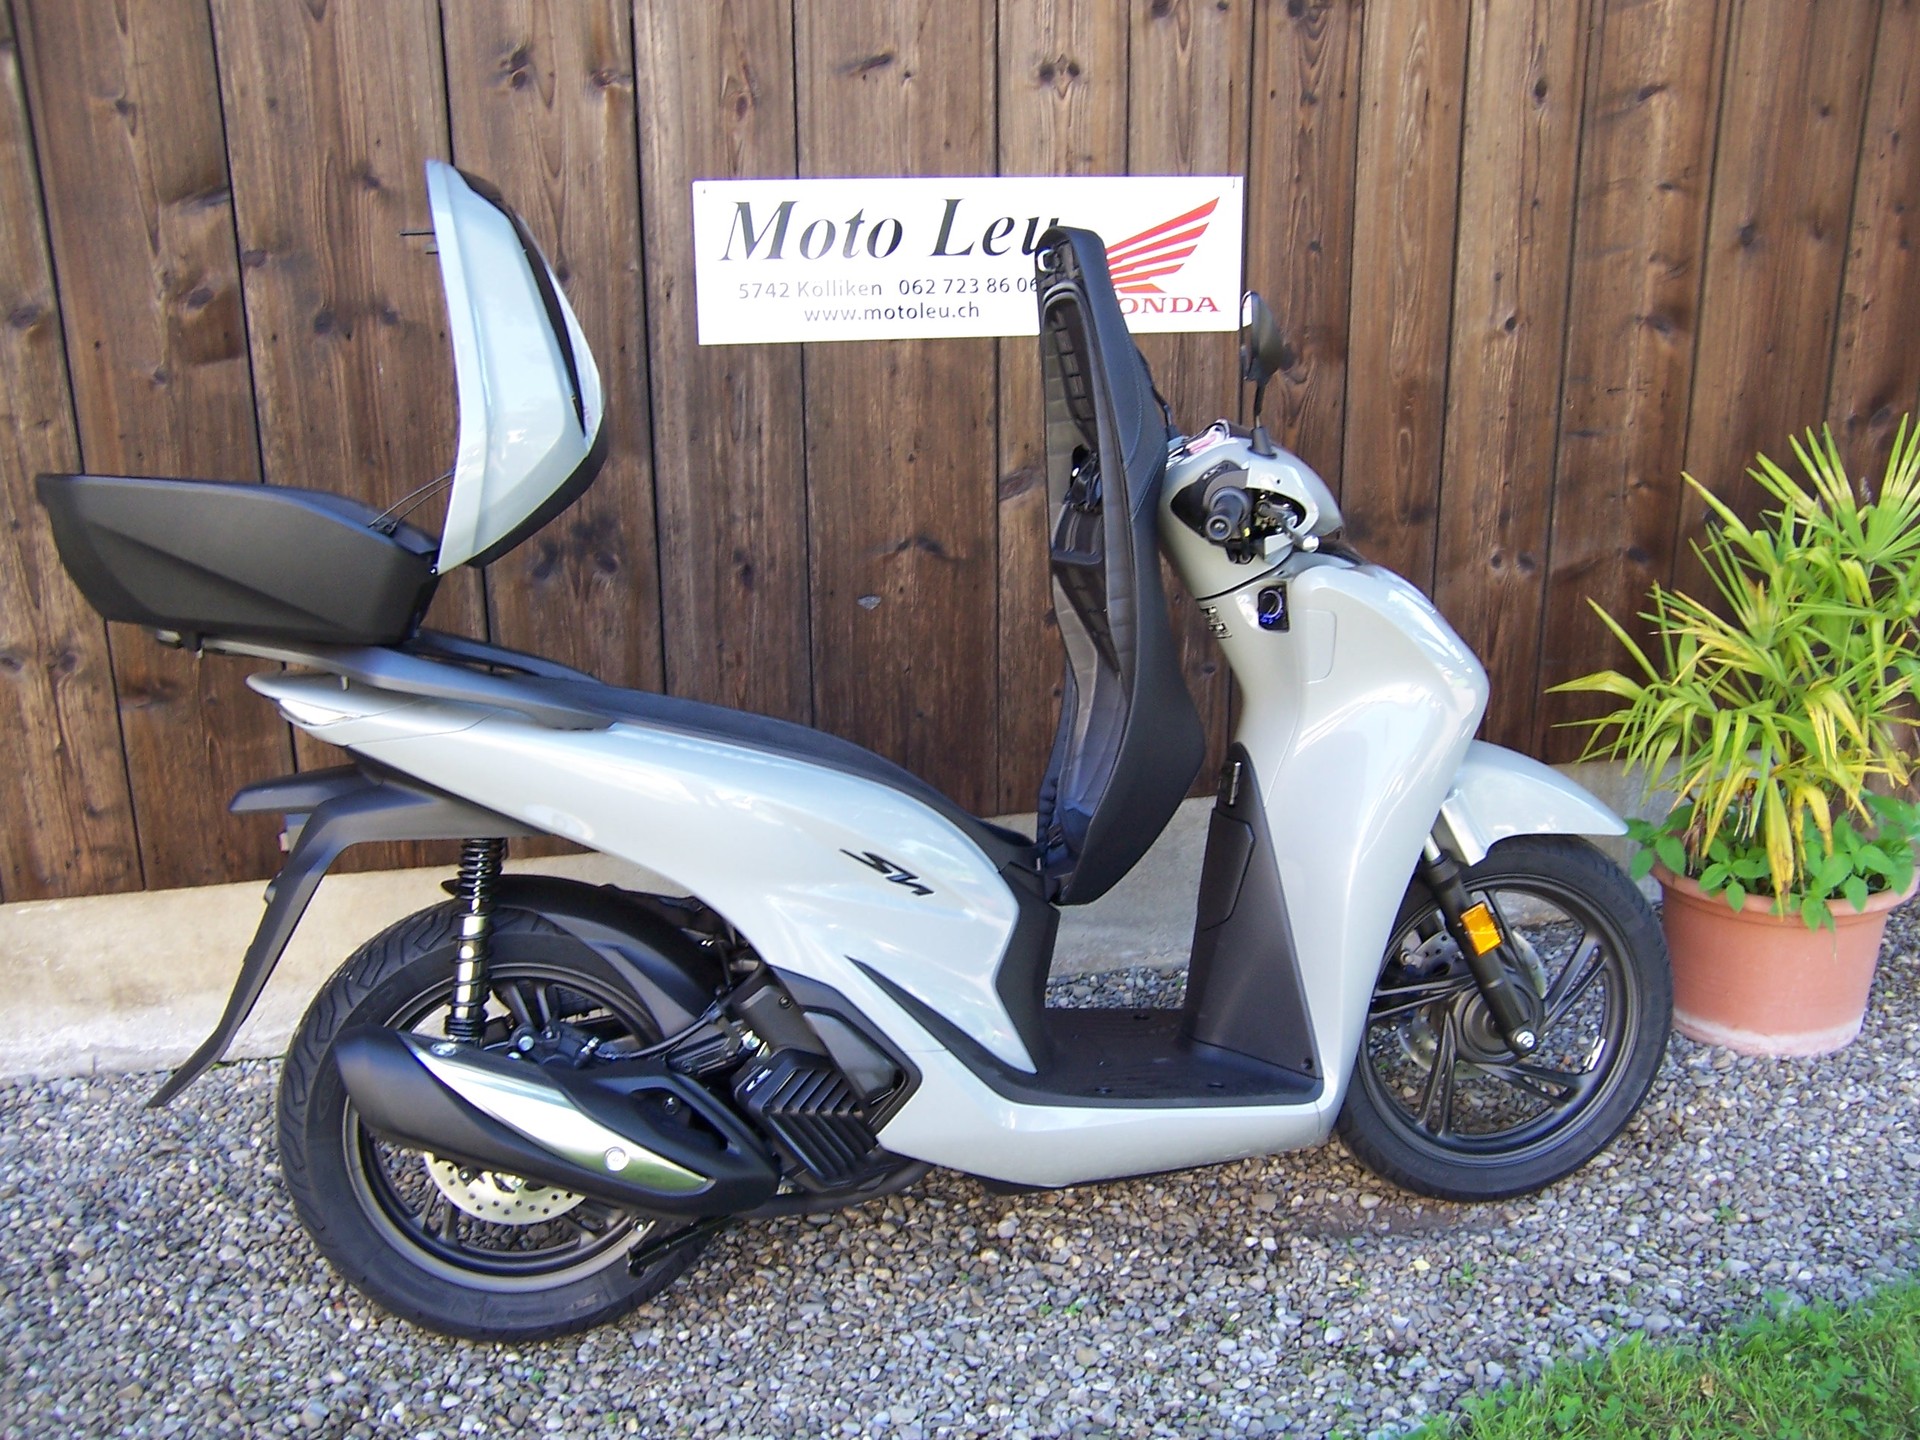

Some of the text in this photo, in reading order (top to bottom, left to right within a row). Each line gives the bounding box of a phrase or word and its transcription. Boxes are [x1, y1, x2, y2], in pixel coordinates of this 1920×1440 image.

[718, 198, 1059, 260] Moto Leu
[739, 282, 790, 299] 5742
[899, 279, 936, 295] 062
[943, 278, 979, 294] 723
[986, 277, 1010, 293] 86
[1016, 277, 1037, 293] 06
[804, 301, 980, 321] www.motoleu.ch
